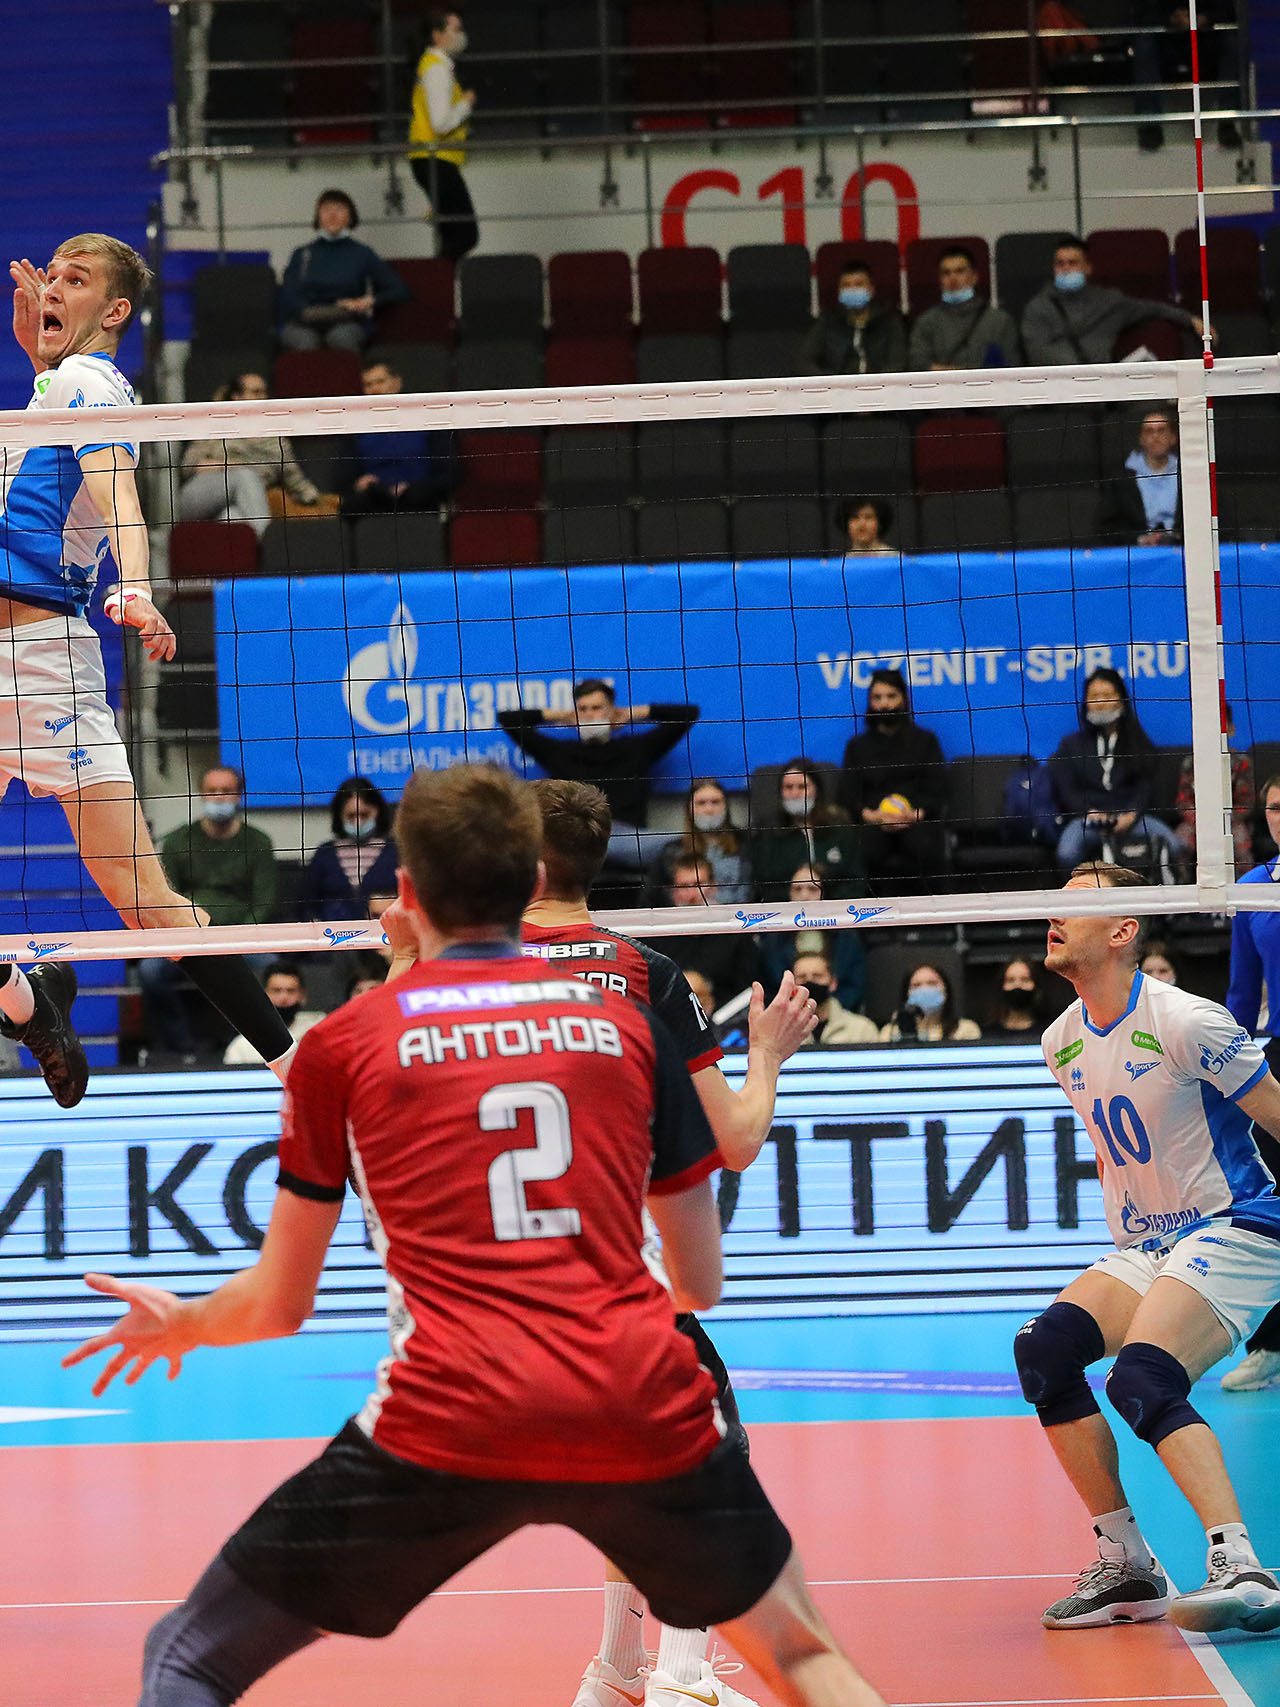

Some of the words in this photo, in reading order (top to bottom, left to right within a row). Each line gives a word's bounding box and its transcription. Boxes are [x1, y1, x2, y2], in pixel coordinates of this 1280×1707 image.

[424, 678, 614, 732] ГАЗПРО
[521, 943, 612, 959] RIBET
[407, 983, 597, 1013] PARIBET
[397, 1016, 624, 1067] АНТОНОВ
[1092, 1094, 1152, 1167] 10
[478, 1081, 582, 1241] 2
[1187, 1263, 1208, 1277] errea
